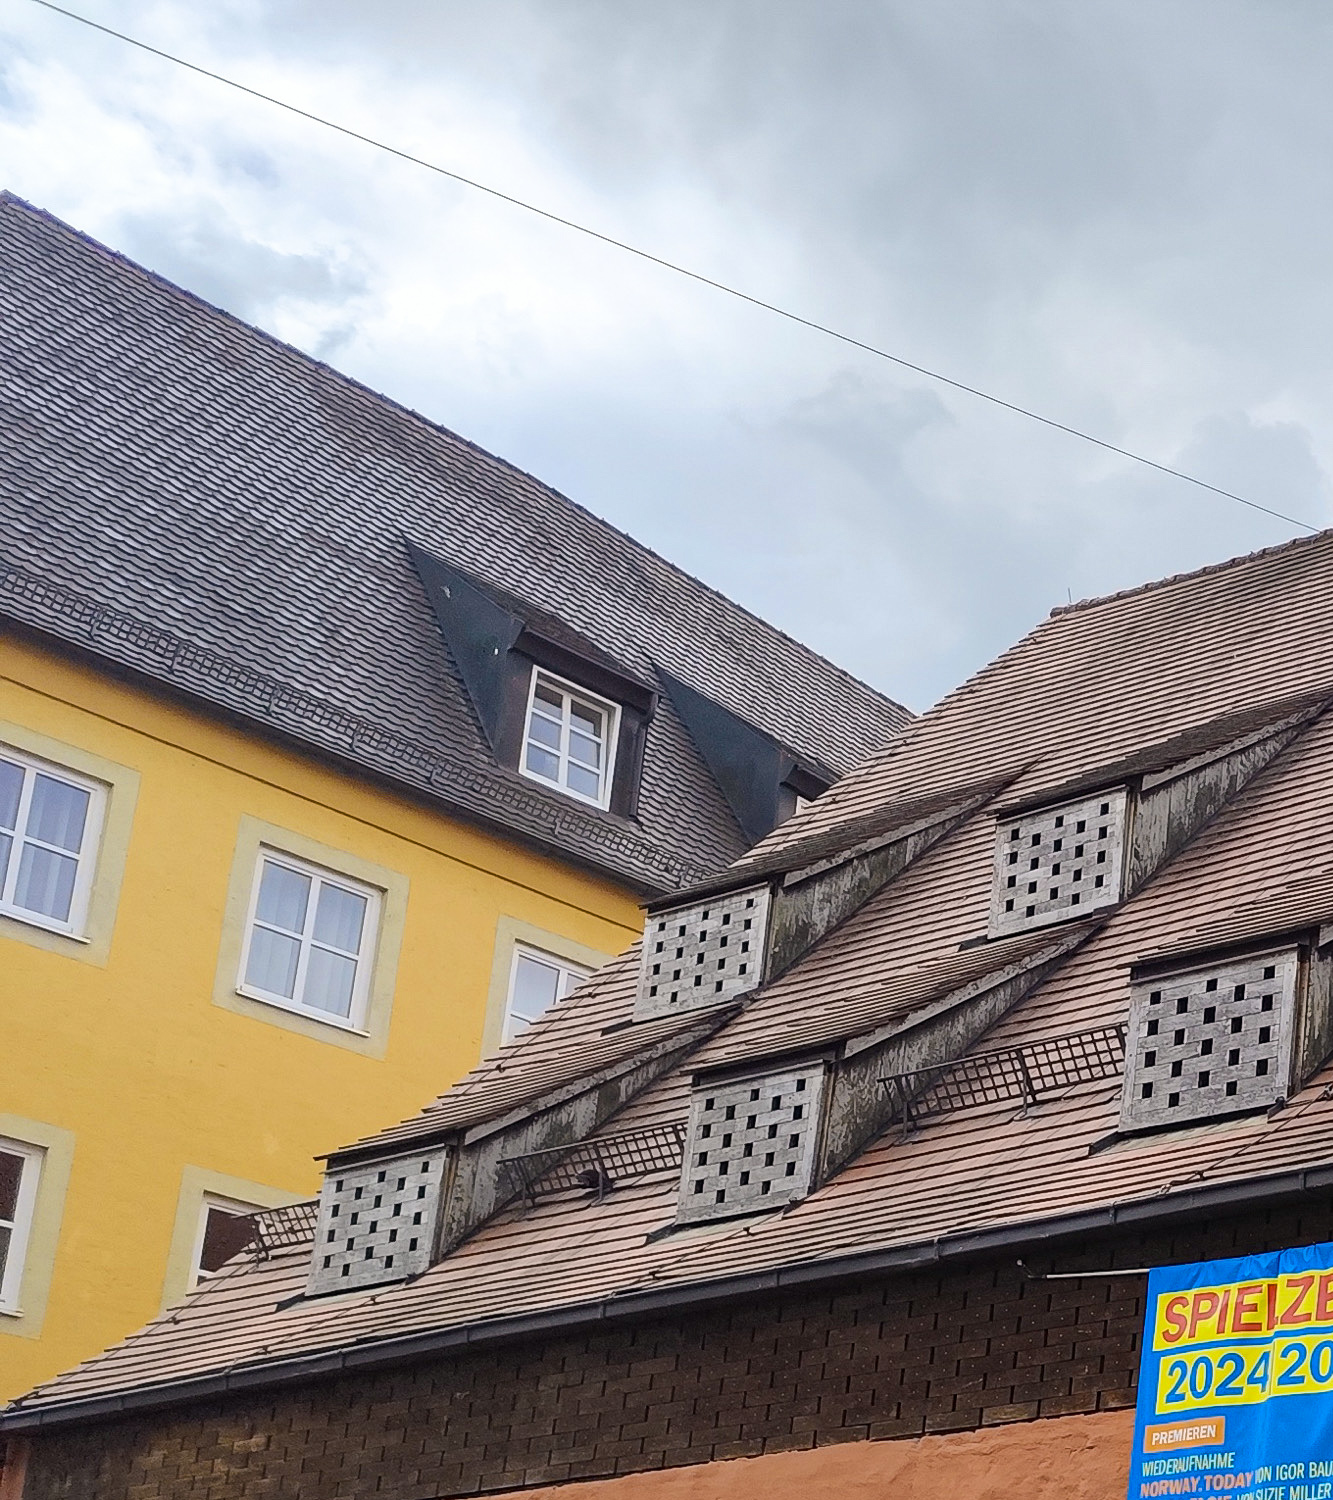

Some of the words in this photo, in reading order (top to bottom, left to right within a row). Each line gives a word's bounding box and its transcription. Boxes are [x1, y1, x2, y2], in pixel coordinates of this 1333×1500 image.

[1151, 1424, 1217, 1446] PREMIEREN
[1141, 1451, 1236, 1477] WIEDERAUFNAHME
[1276, 1462, 1305, 1481] IGOR
